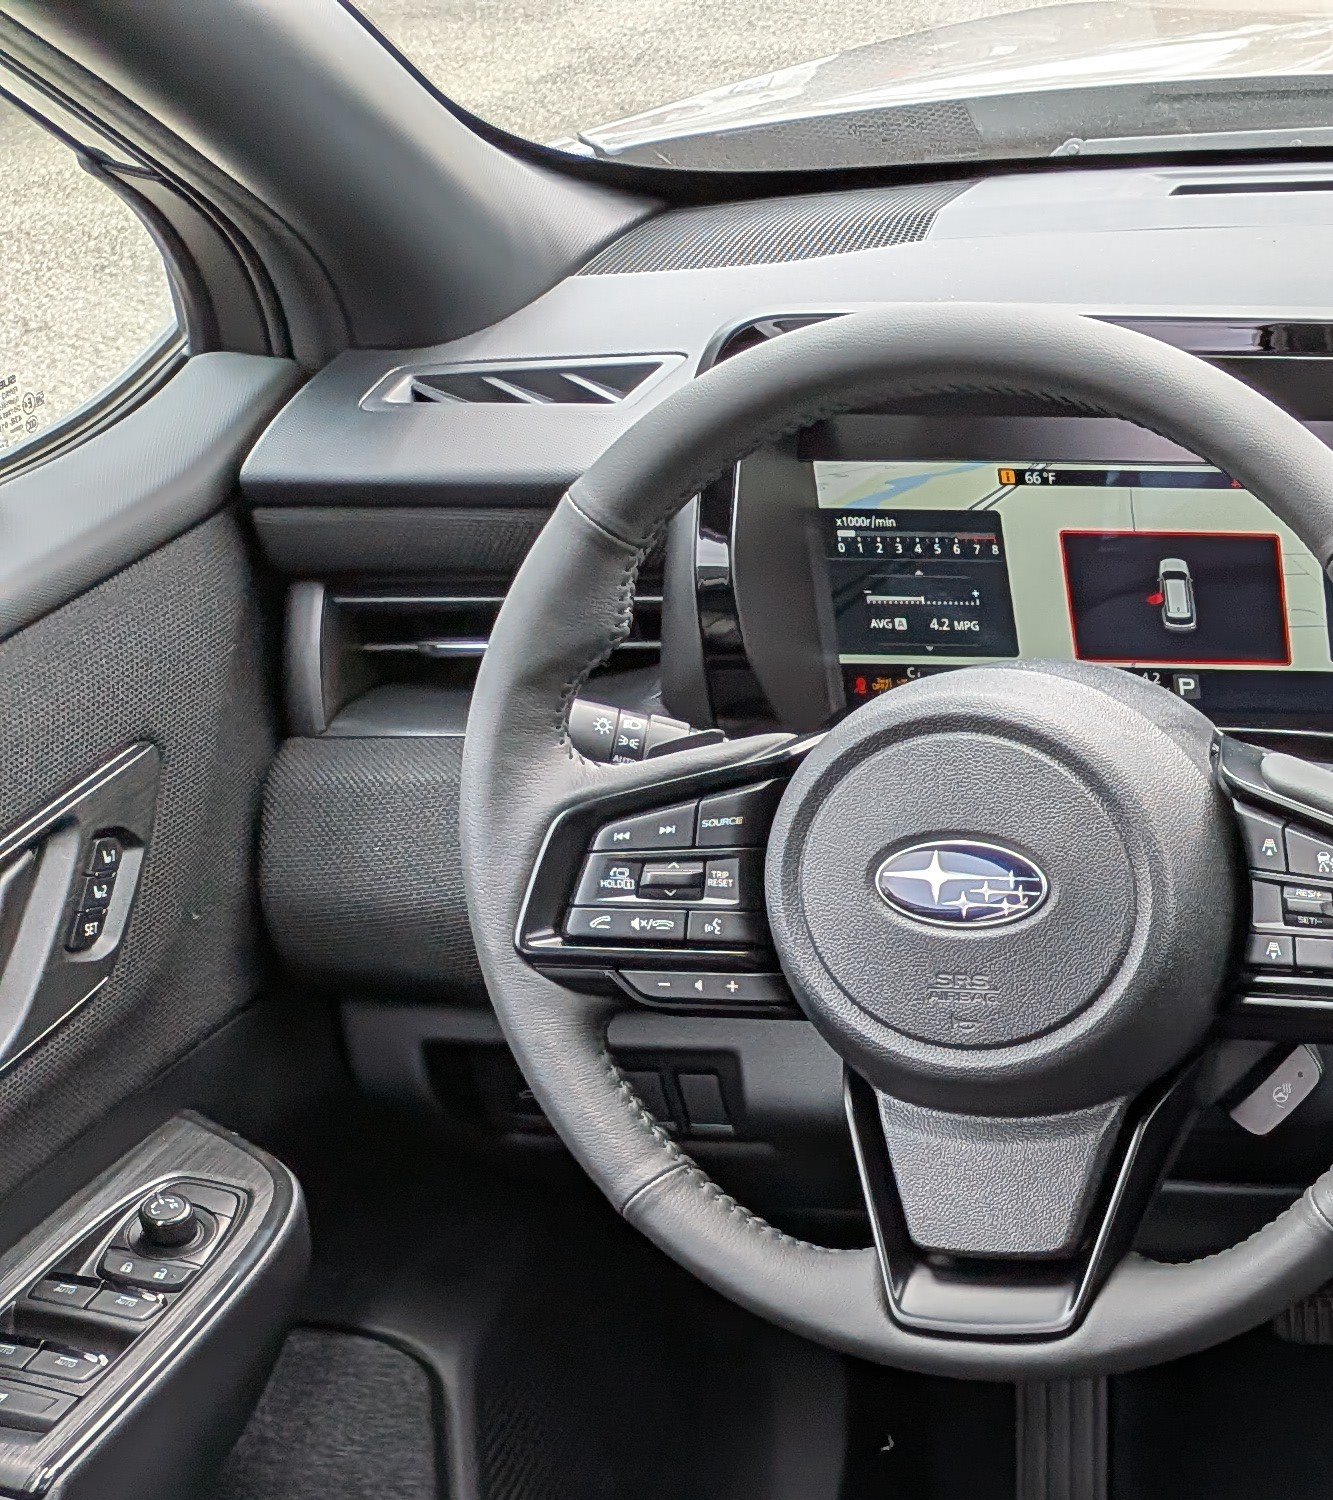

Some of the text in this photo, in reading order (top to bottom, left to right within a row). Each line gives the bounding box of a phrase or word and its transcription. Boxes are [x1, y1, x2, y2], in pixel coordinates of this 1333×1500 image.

[835, 515, 897, 527] x1000r/min
[838, 543, 1000, 555] 0 1 2 3 4 5 6 7 8
[870, 618, 893, 630] AVG
[929, 618, 951, 631] 4.2
[954, 620, 980, 631] MPG
[1178, 678, 1195, 696] P
[701, 816, 744, 828] SOURCE
[936, 973, 990, 989] SRS
